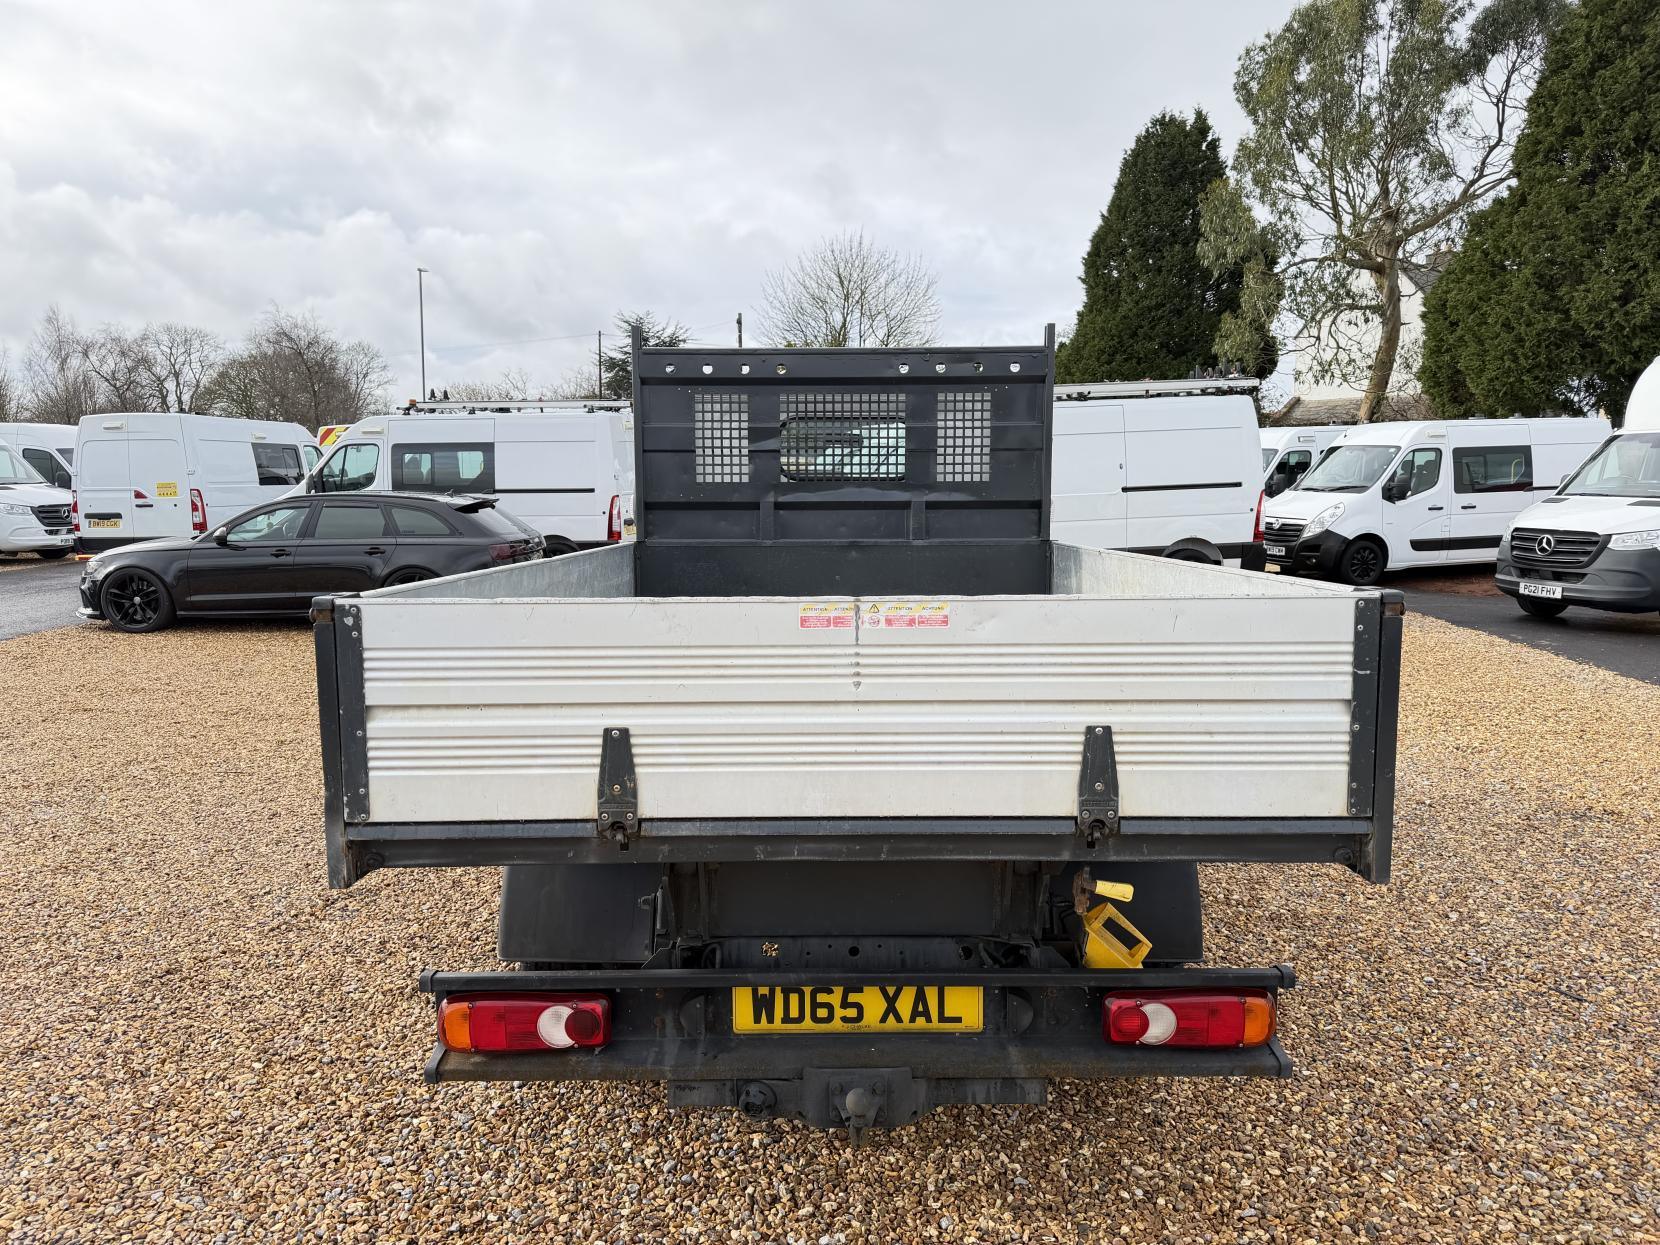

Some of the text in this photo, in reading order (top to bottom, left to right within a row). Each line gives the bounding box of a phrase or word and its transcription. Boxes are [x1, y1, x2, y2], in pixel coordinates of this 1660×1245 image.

[1523, 584, 1557, 596] PG21 FHV
[752, 986, 962, 1024] WD65 XAL
